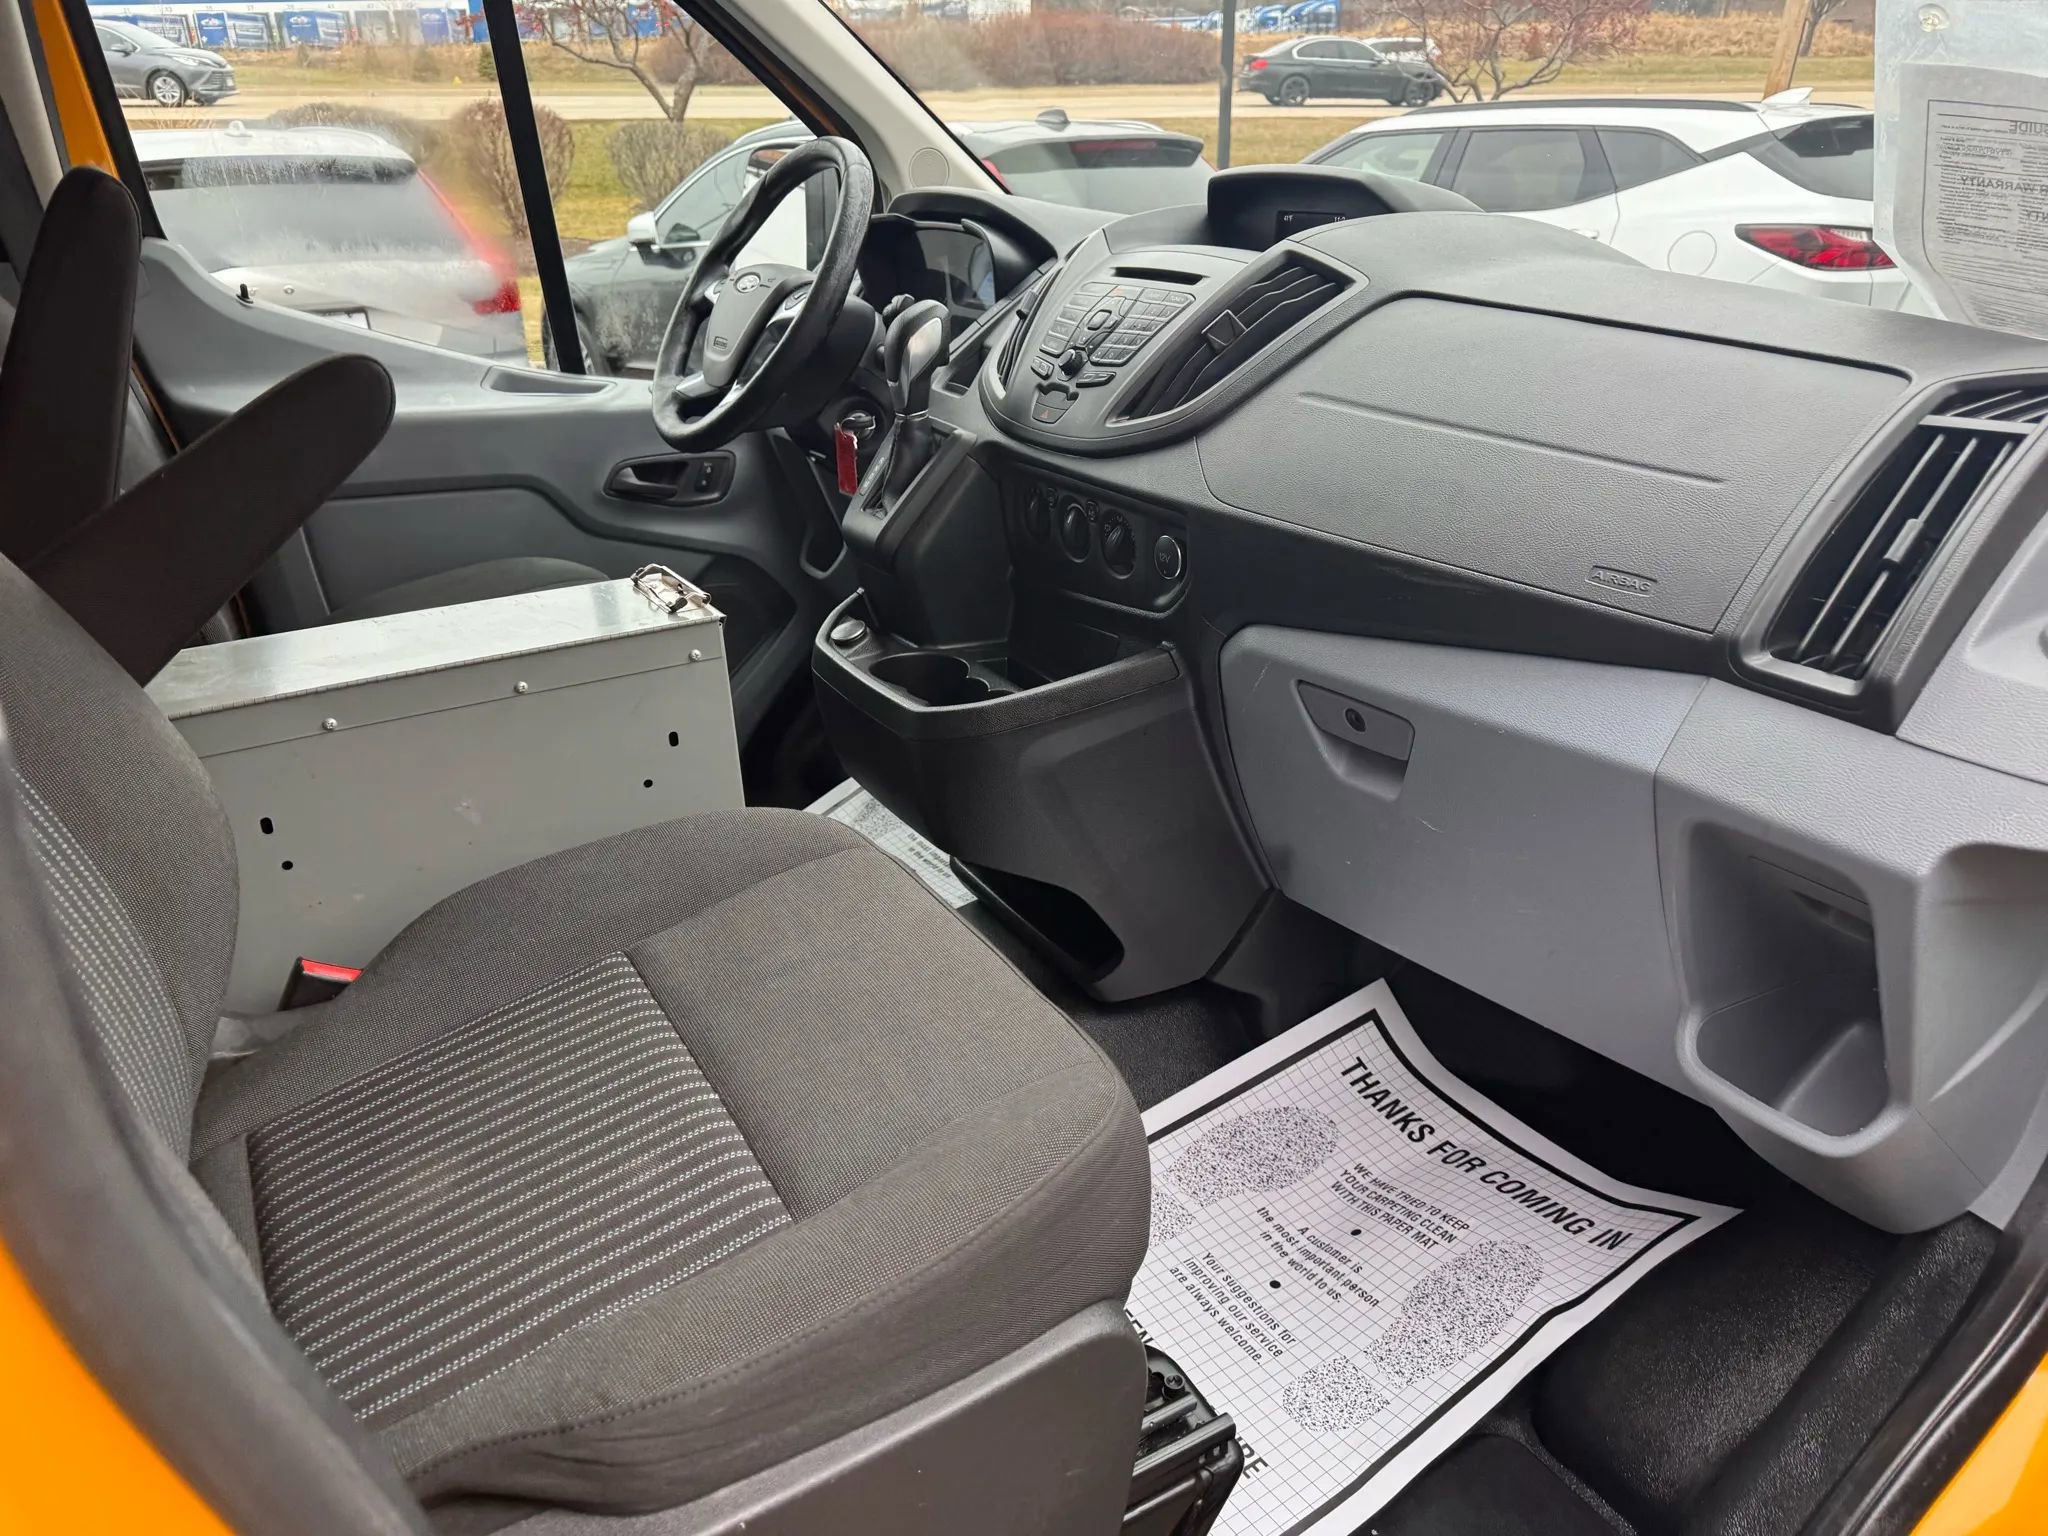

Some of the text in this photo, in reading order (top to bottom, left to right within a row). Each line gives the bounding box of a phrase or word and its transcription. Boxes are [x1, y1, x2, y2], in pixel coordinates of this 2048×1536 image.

[1341, 1056, 1633, 1250] THANKS FOR COMING IN
[1331, 1180, 1439, 1250] WITH THIS PAPER MAT
[1340, 1169, 1457, 1243] YOUR CARPETING CLEAN
[1353, 1162, 1470, 1231] WE HAVE TRIED TO KEEP
[1257, 1206, 1380, 1308] the most important person
[1260, 1229, 1342, 1303] in the world to us.
[1298, 1226, 1363, 1274] A customer is
[1169, 1266, 1262, 1366] are always welcome.
[1183, 1256, 1284, 1358] improving our service
[1202, 1252, 1297, 1345] Your suggestions for
